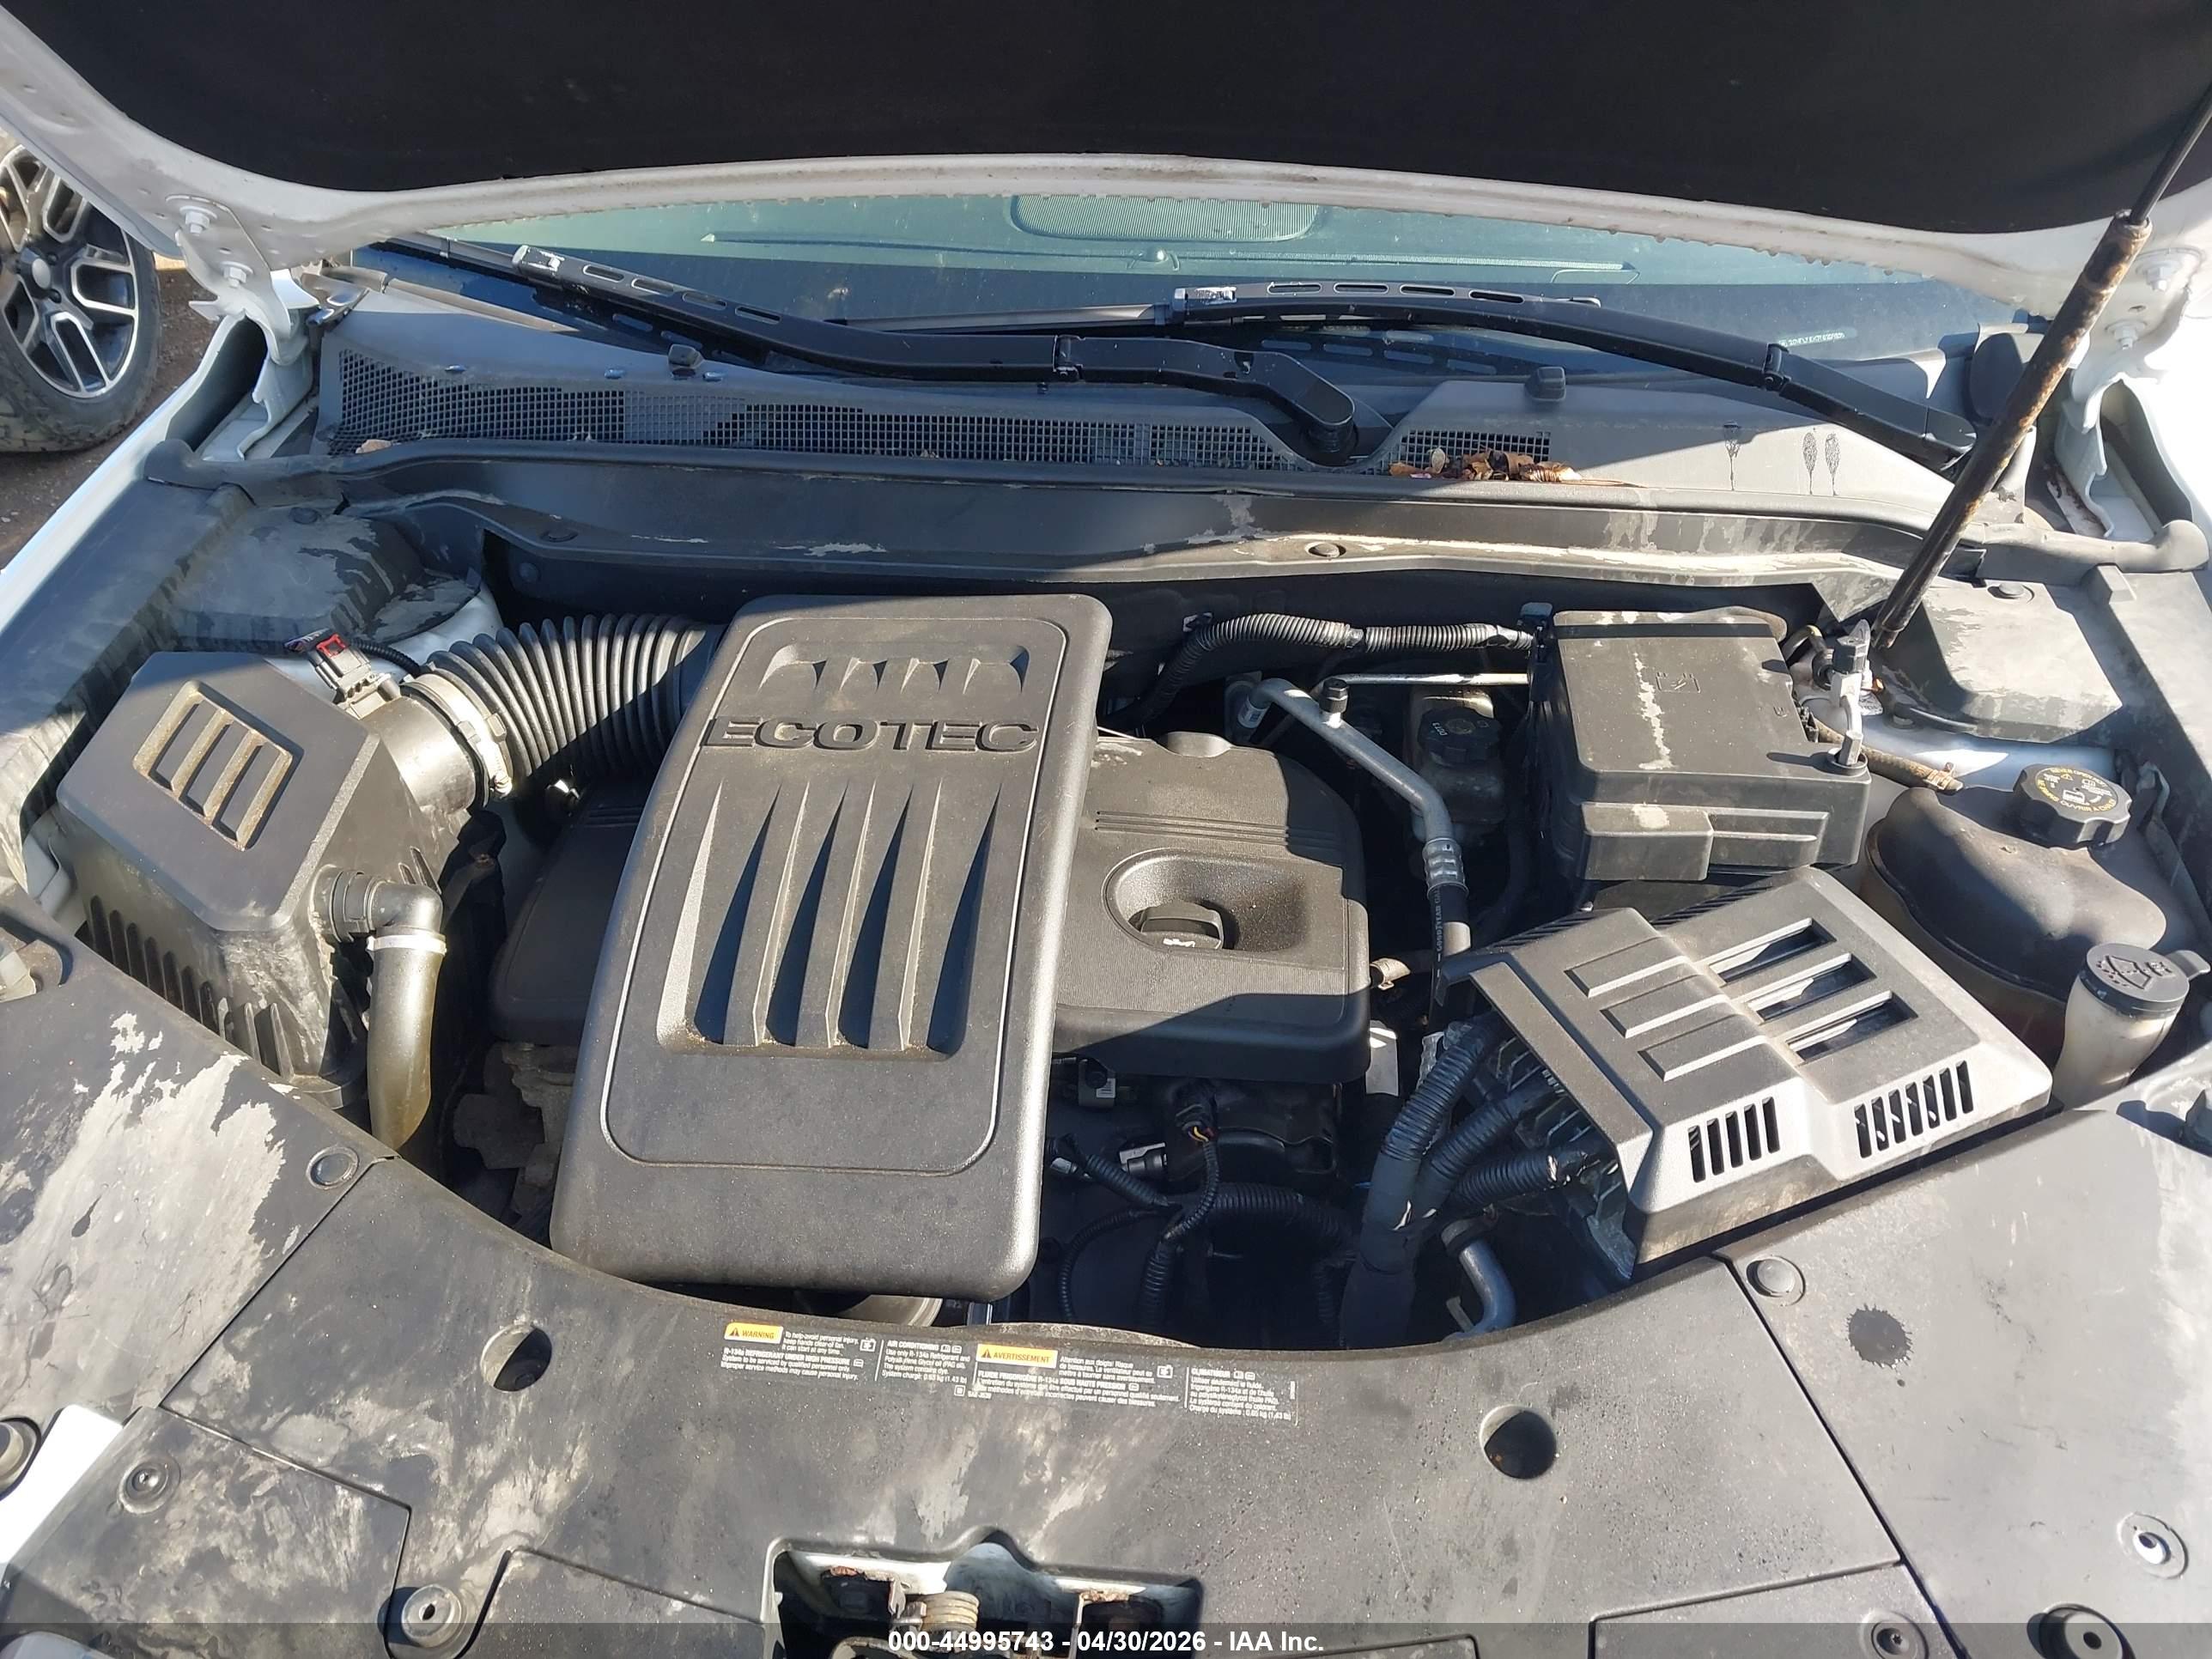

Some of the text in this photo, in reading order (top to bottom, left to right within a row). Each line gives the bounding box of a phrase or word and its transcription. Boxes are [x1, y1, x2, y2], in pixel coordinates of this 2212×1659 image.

[701, 716, 1038, 752] ECOTEC
[742, 1330, 774, 1339] WARNING
[993, 1352, 1050, 1363] AVERTISSEMENT
